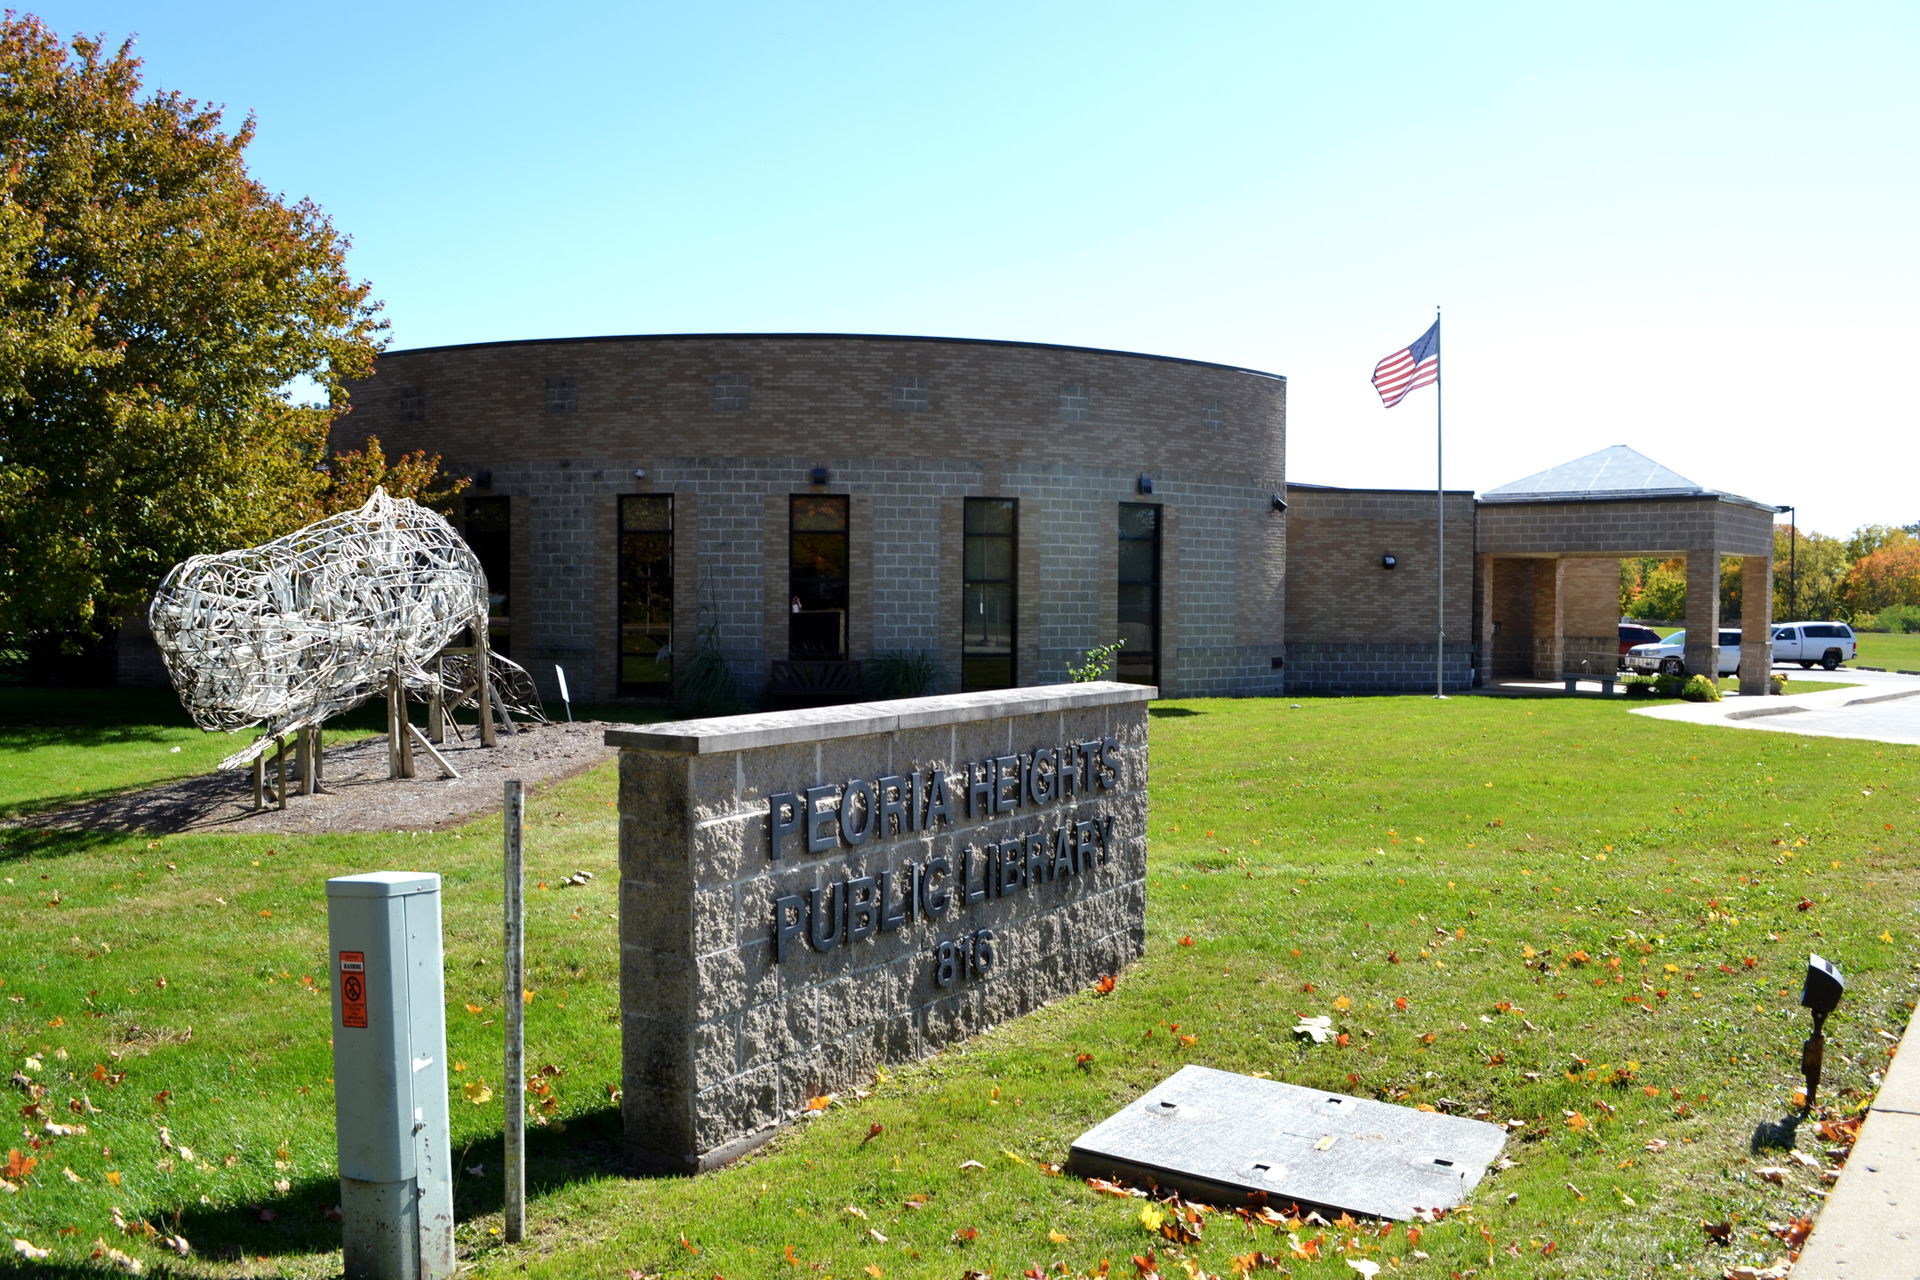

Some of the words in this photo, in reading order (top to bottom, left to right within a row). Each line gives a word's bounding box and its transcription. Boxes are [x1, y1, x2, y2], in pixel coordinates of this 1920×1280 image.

[770, 770, 953, 861] PEORIA
[967, 737, 1121, 818] HEIGHTS
[776, 857, 951, 963] PUBLIC
[964, 815, 1115, 906] LIBRARY
[936, 929, 994, 988] 816
